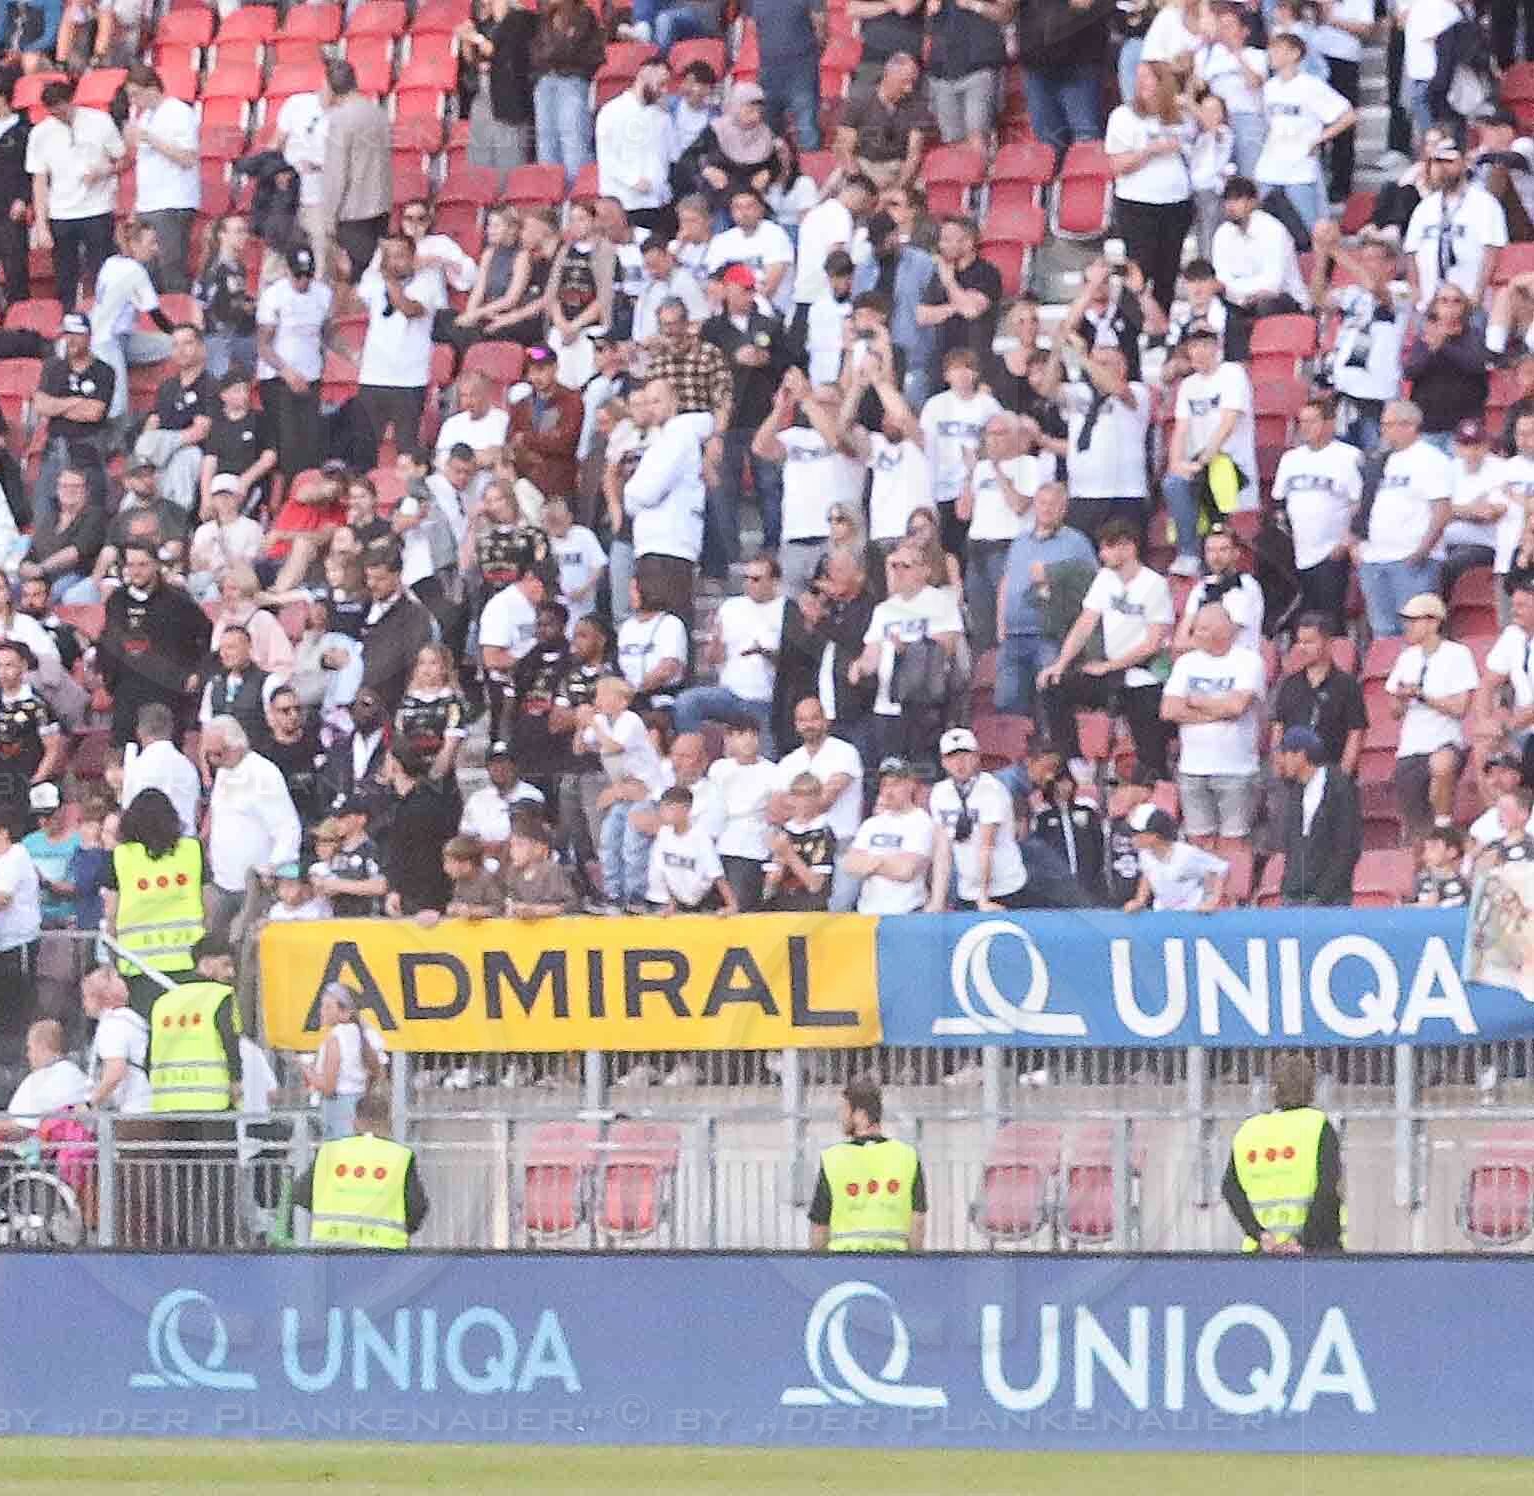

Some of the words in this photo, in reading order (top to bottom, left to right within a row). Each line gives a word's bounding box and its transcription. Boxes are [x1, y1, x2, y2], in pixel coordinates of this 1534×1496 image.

[302, 935, 860, 1034] ADMIRAL
[1110, 933, 1480, 1039] UNIQA
[280, 1304, 585, 1396] UNIQA
[980, 1301, 1378, 1416] UNIQA
